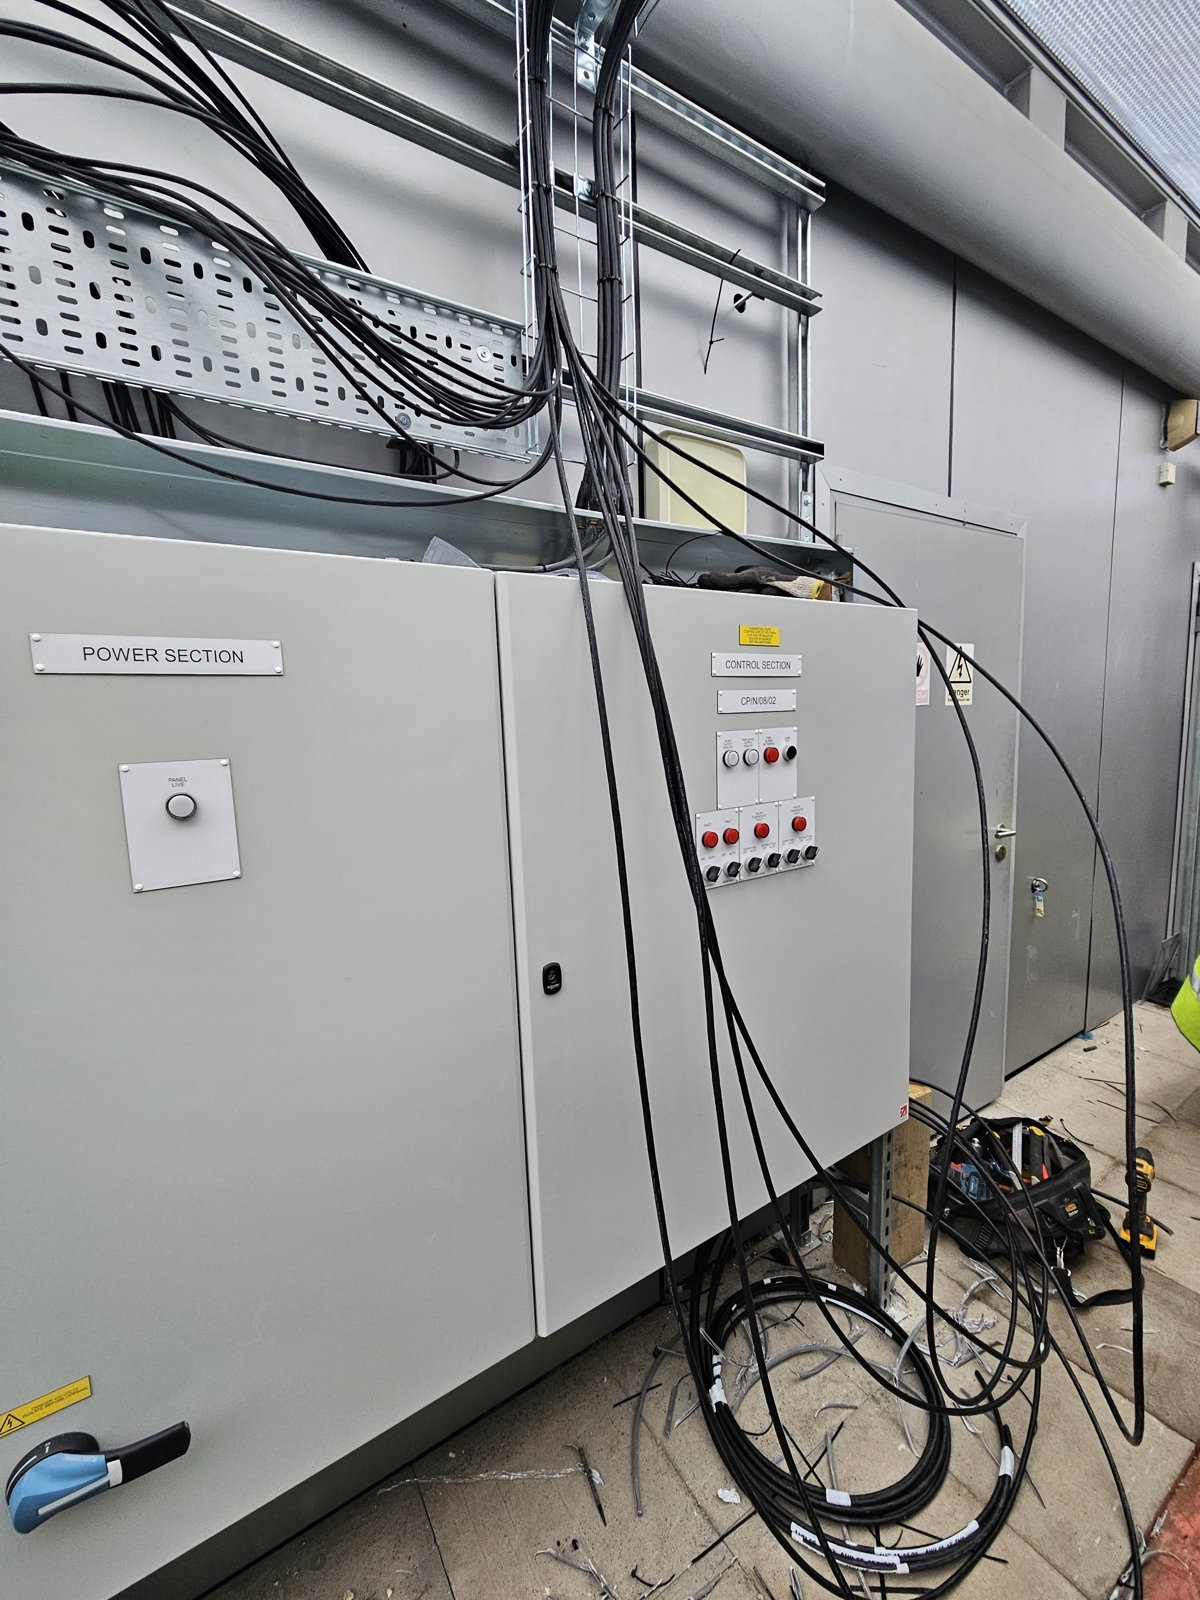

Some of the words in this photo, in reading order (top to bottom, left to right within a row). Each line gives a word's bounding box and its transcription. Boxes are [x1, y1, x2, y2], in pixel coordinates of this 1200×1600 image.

[82, 646, 159, 662] POWER
[165, 648, 244, 664] SECTION
[725, 660, 760, 670] CONTROL
[761, 660, 791, 670] SECTION
[949, 688, 970, 698] anger
